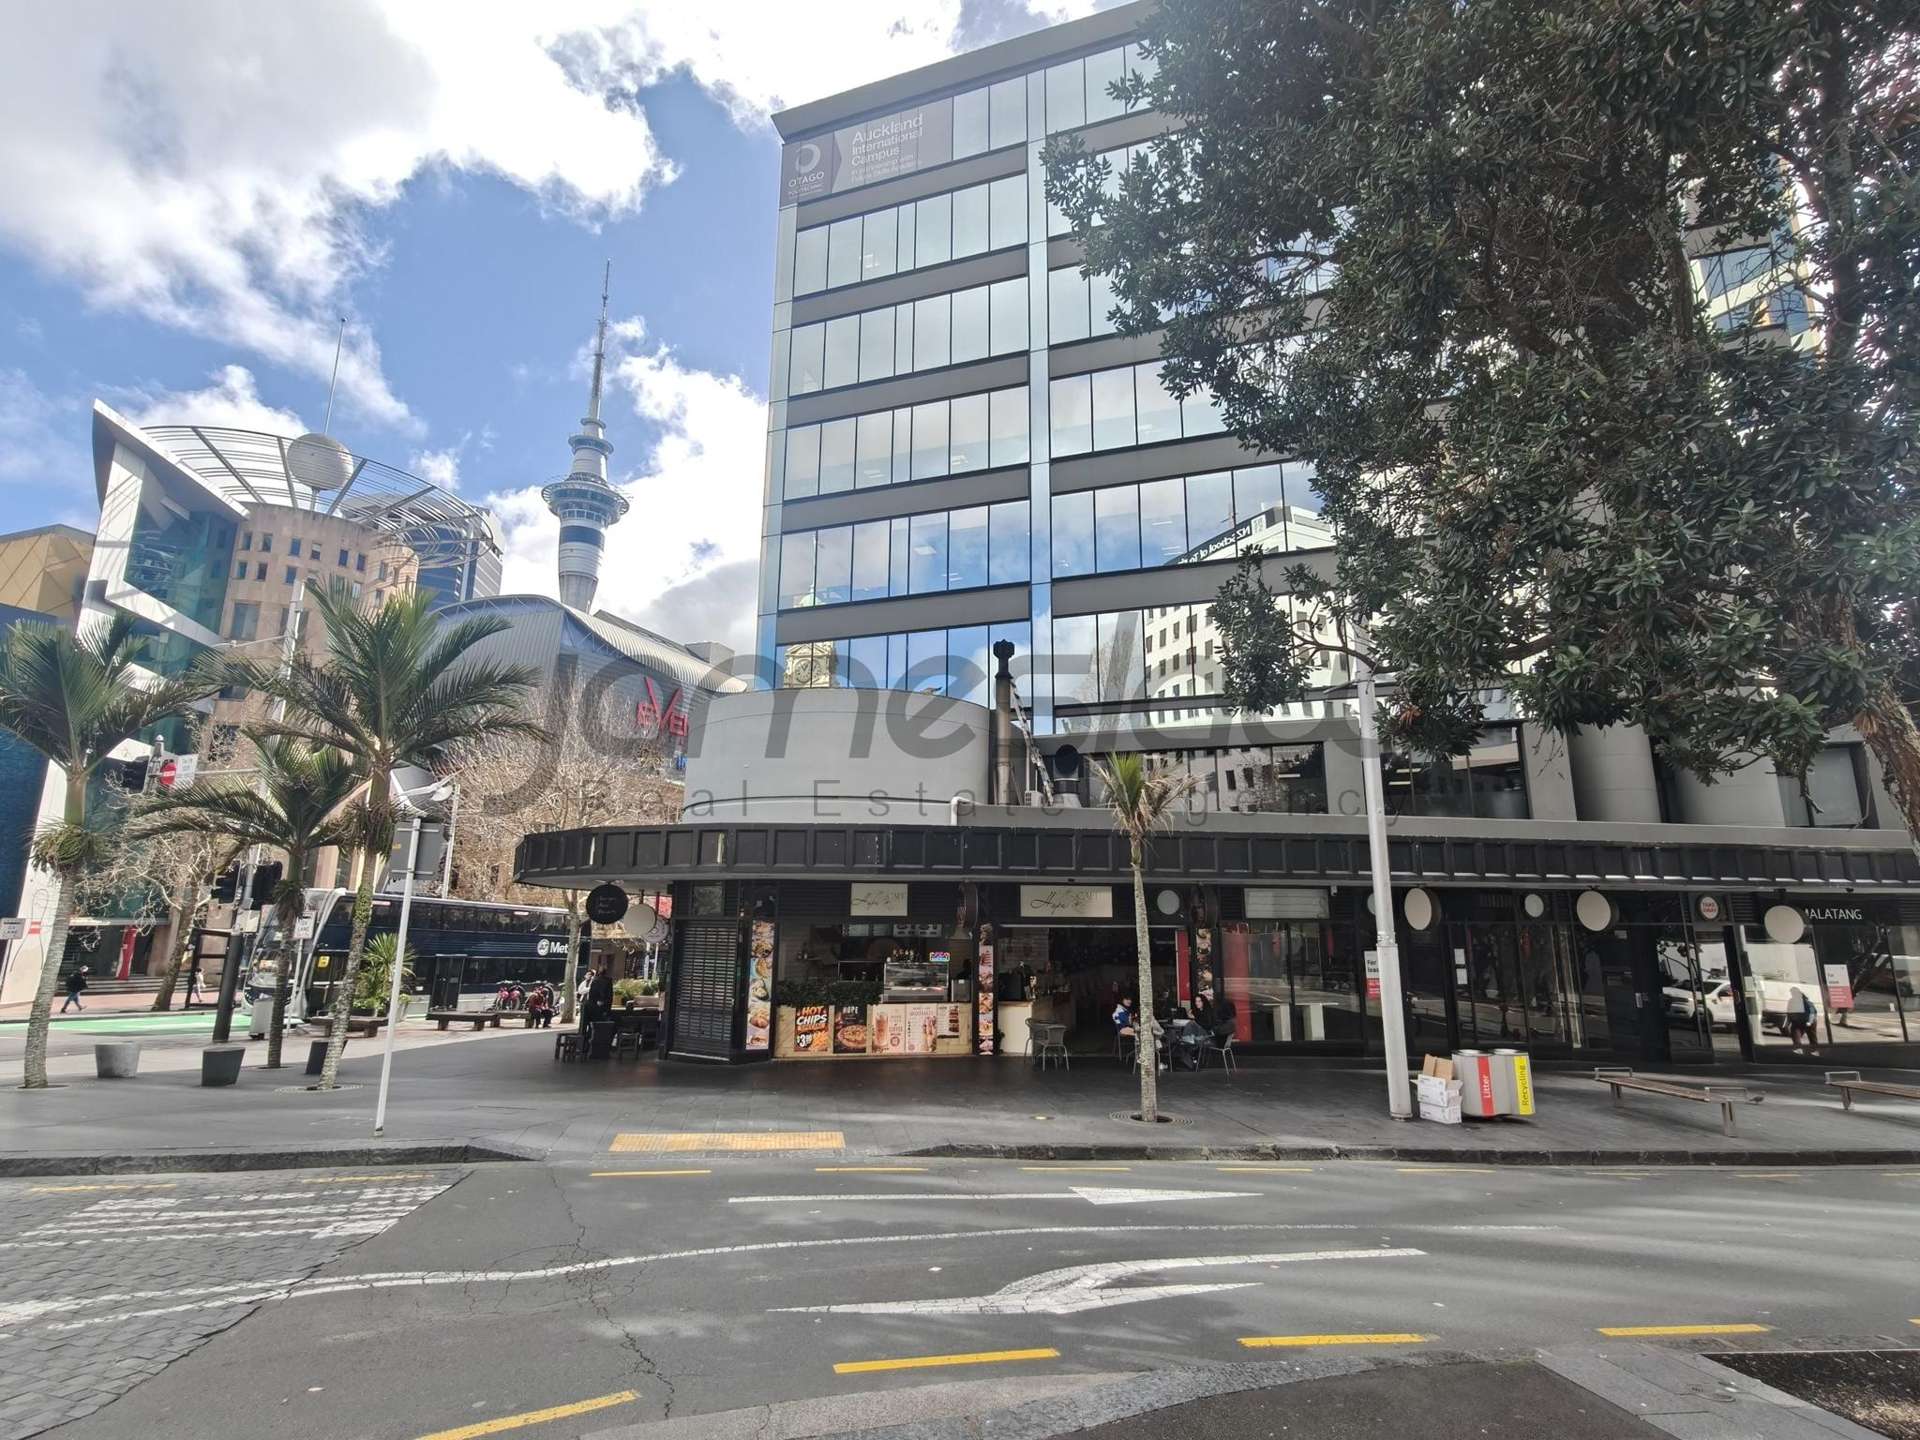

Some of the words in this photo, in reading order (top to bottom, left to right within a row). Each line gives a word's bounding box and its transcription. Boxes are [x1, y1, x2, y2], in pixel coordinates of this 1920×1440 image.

[852, 113, 923, 145] Auckland
[851, 127, 923, 155] International
[851, 146, 900, 167] Campus
[788, 171, 825, 188] OTAGO
[550, 942, 569, 953] Met
[797, 1014, 827, 1025] CHIPS
[802, 1006, 824, 1015] HOT
[1483, 1075, 1492, 1099] Litter
[1519, 1064, 1529, 1106] Recycling
